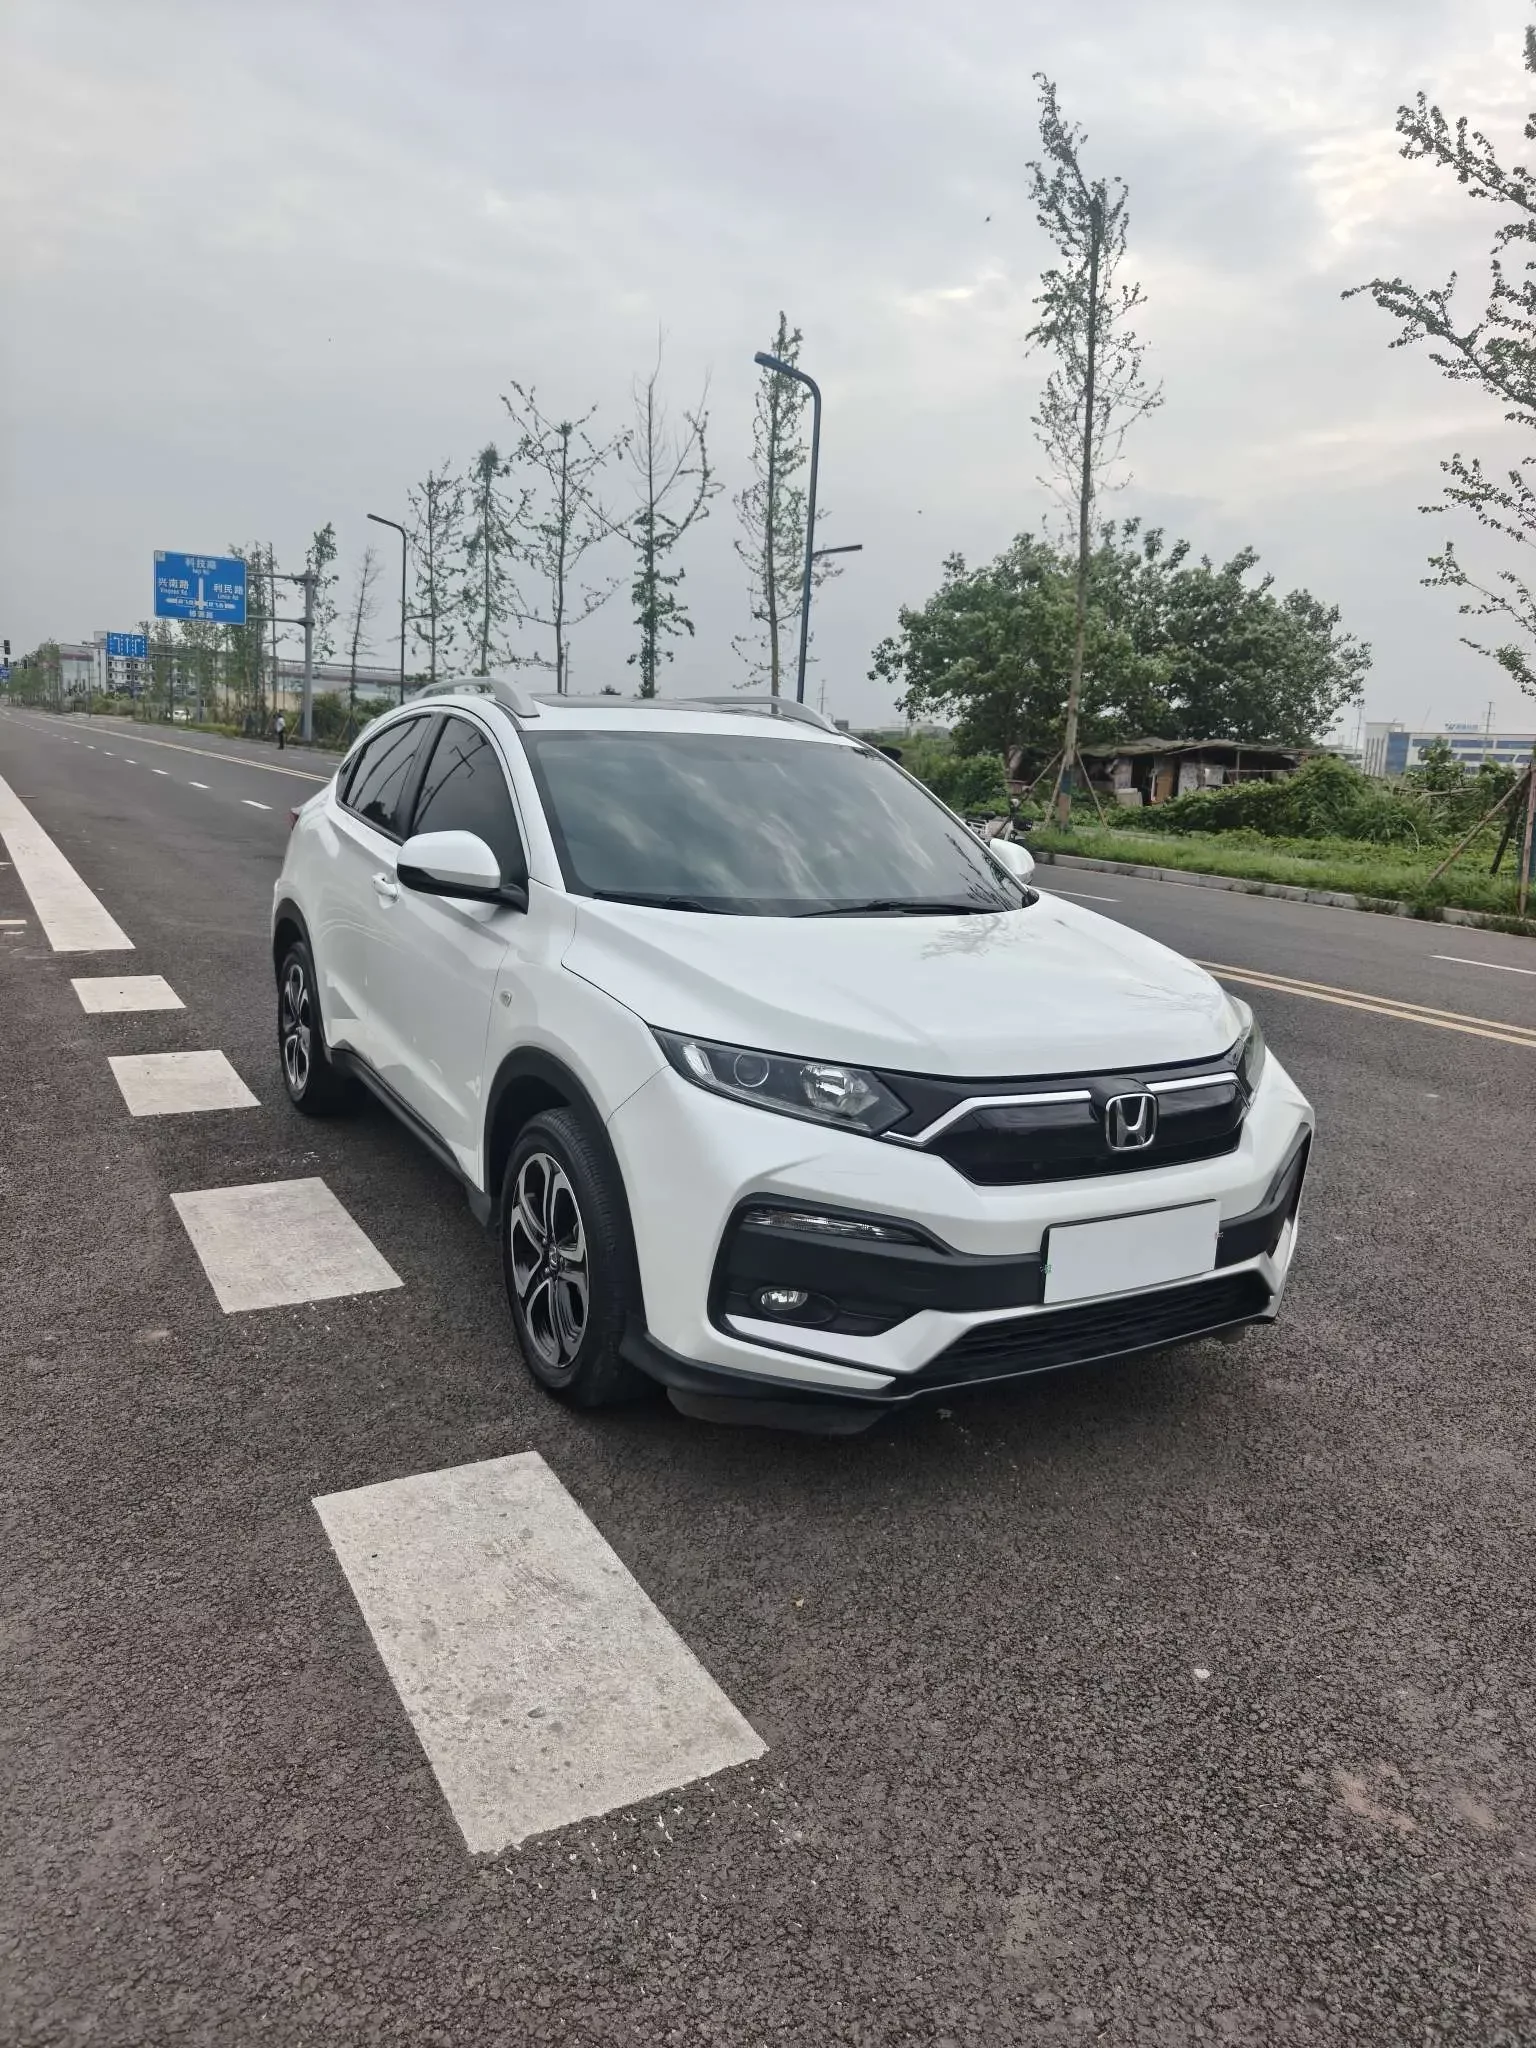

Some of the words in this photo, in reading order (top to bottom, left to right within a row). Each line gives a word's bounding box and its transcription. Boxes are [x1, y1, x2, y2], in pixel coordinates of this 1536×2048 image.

[158, 577, 189, 589] 兴南路
[213, 584, 243, 595] 利民路
